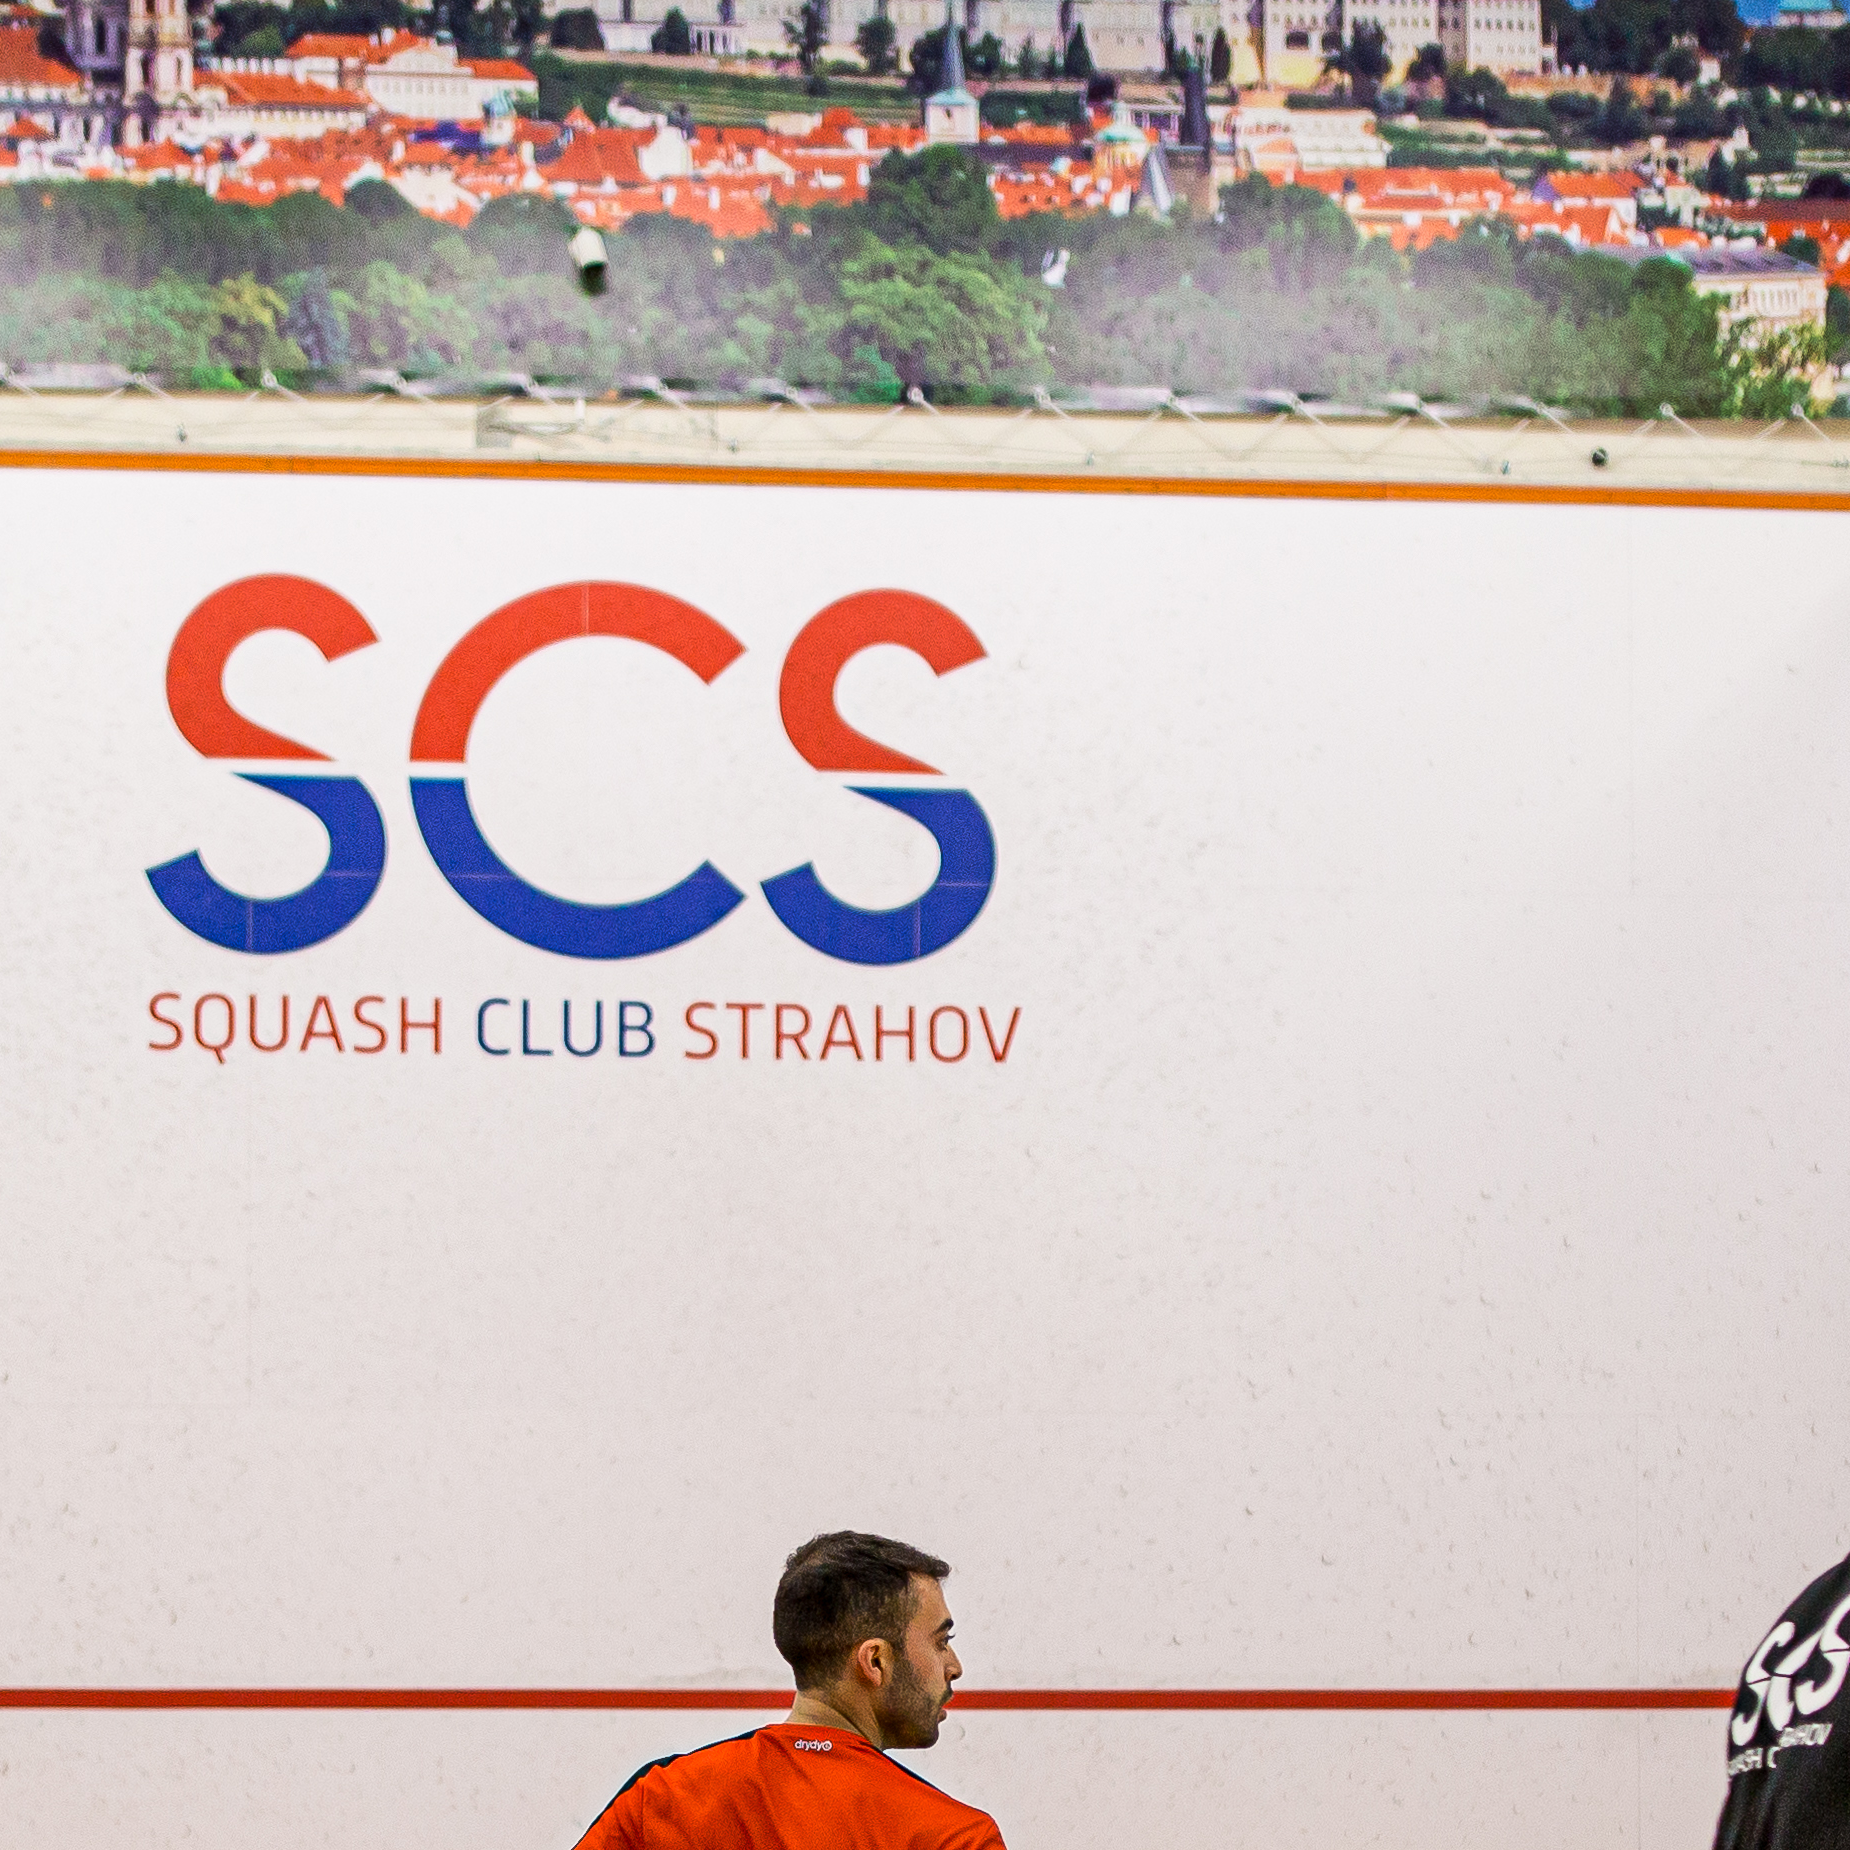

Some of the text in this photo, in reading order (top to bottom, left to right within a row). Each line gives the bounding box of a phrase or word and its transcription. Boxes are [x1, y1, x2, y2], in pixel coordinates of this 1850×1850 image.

[144, 573, 997, 967] SCS
[148, 992, 1023, 1065] SQUASH CLUB STRAHOV
